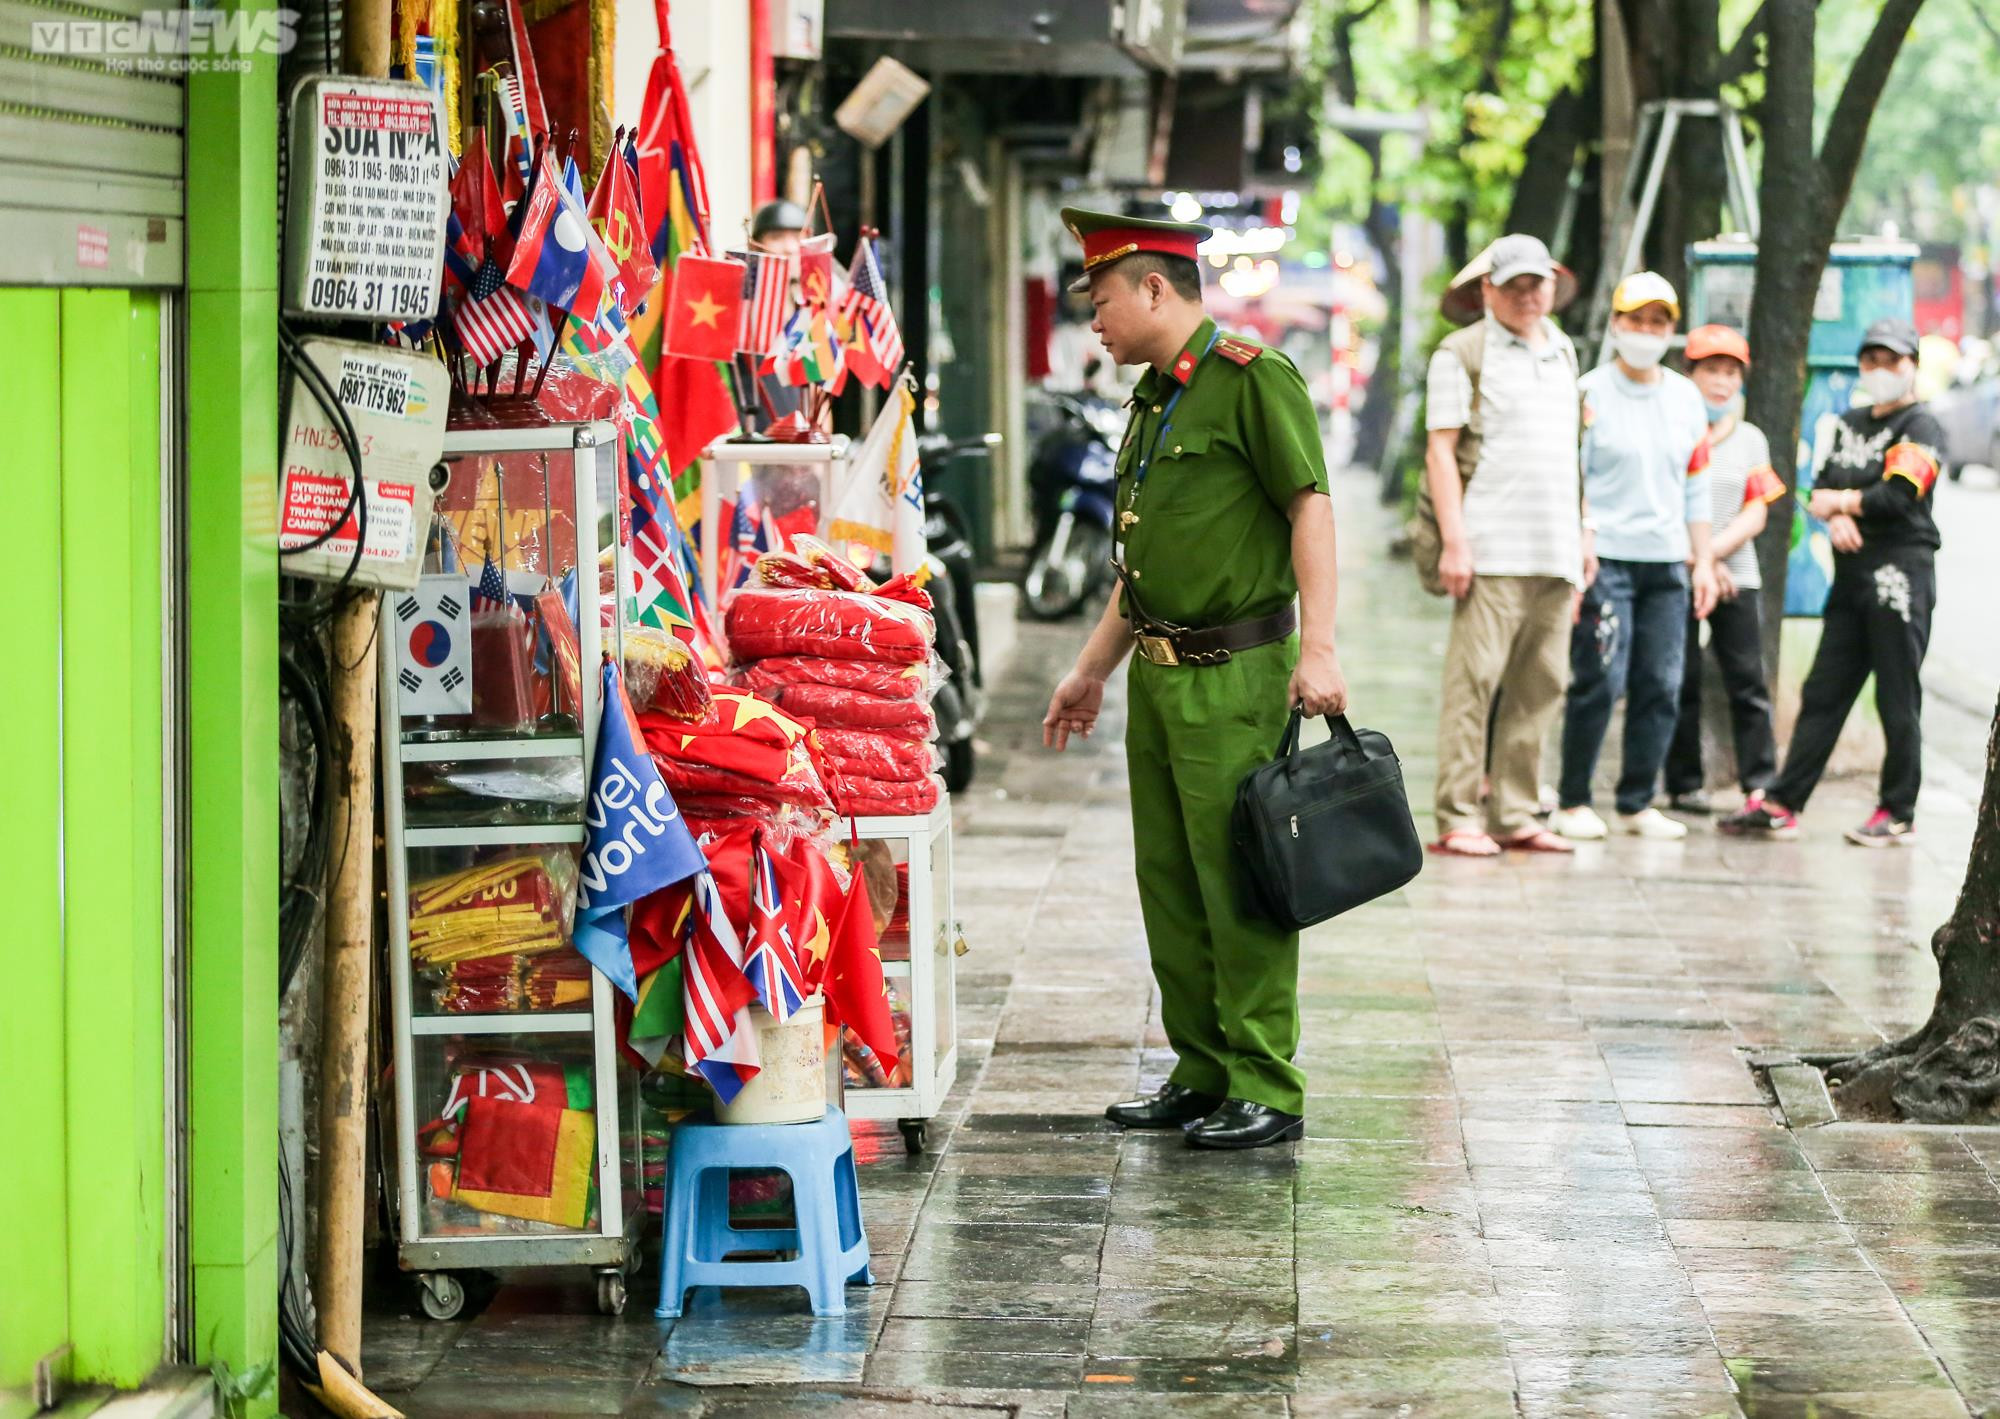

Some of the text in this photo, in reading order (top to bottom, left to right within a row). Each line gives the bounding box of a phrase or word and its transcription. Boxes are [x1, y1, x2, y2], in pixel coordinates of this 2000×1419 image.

[325, 158, 346, 178] 0964
[349, 160, 359, 179] 31
[363, 161, 382, 180] 1945
[390, 163, 408, 184] 0964
[411, 166, 419, 185] 31
[311, 277, 430, 315] 0964 31 1945
[292, 481, 343, 496] INTERNET
[381, 487, 411, 498] viettel
[290, 505, 327, 520] TRUYỀN
[286, 518, 331, 531] CAMERA
